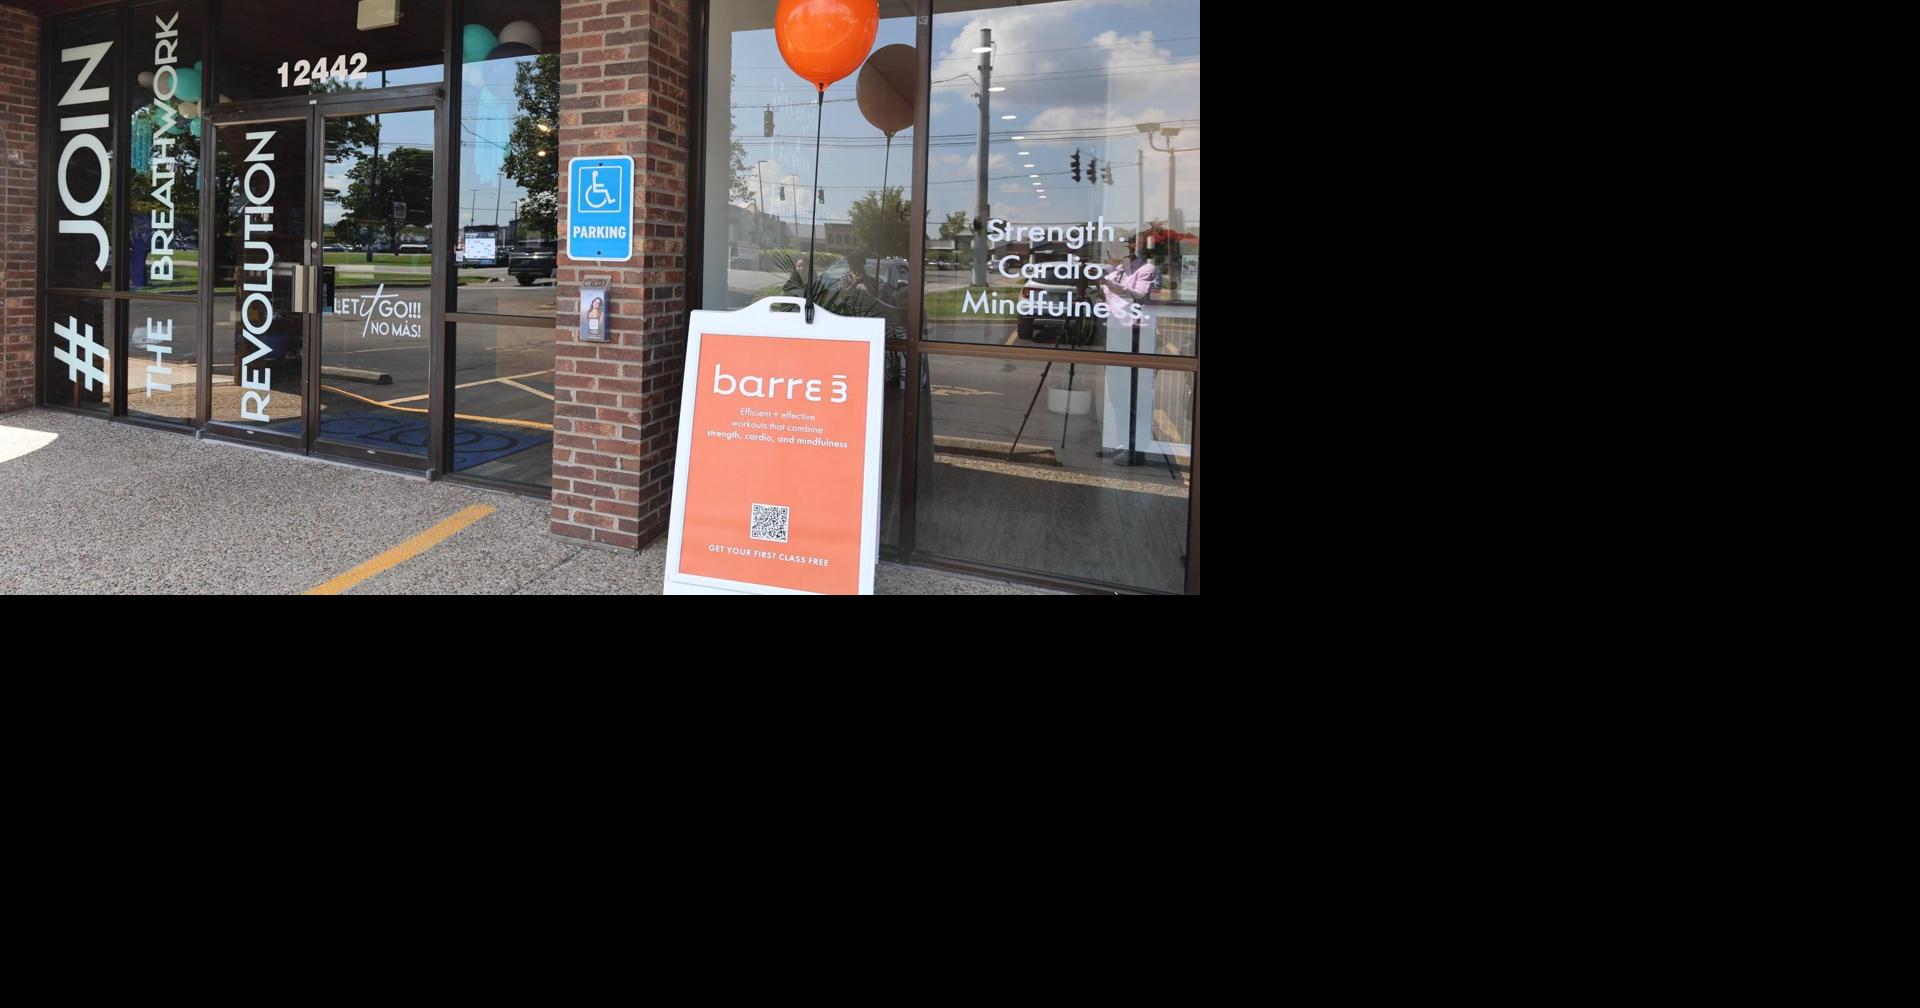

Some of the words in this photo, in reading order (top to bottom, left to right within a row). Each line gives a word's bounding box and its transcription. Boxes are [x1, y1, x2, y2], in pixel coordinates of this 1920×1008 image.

[277, 52, 368, 88] 12442
[57, 41, 114, 272] JOIN
[151, 11, 179, 281] BREATHWORK
[573, 225, 627, 239] PARKING
[987, 216, 1125, 250] Strength.
[241, 130, 276, 422] REVOLUTION
[998, 254, 1109, 280] Cardio.
[334, 298, 360, 315] LET
[379, 300, 421, 319] GO!!!
[961, 290, 1150, 320] Mindfulness.
[371, 321, 390, 335] NO
[54, 315, 110, 392] #
[146, 317, 173, 398] THE
[731, 420, 767, 430] workouts
[769, 422, 785, 432] that
[787, 424, 823, 434] combine
[740, 407, 772, 418] Efficient
[781, 411, 816, 421] effective
[707, 429, 742, 441] strength,
[745, 432, 774, 444] cardio,
[778, 436, 795, 445] and
[797, 437, 848, 449] mindfulness
[708, 544, 724, 553] GET
[727, 547, 751, 557] YOUR
[754, 550, 777, 560] FIRST
[779, 553, 806, 564] CLASS
[808, 557, 829, 567] FREE
